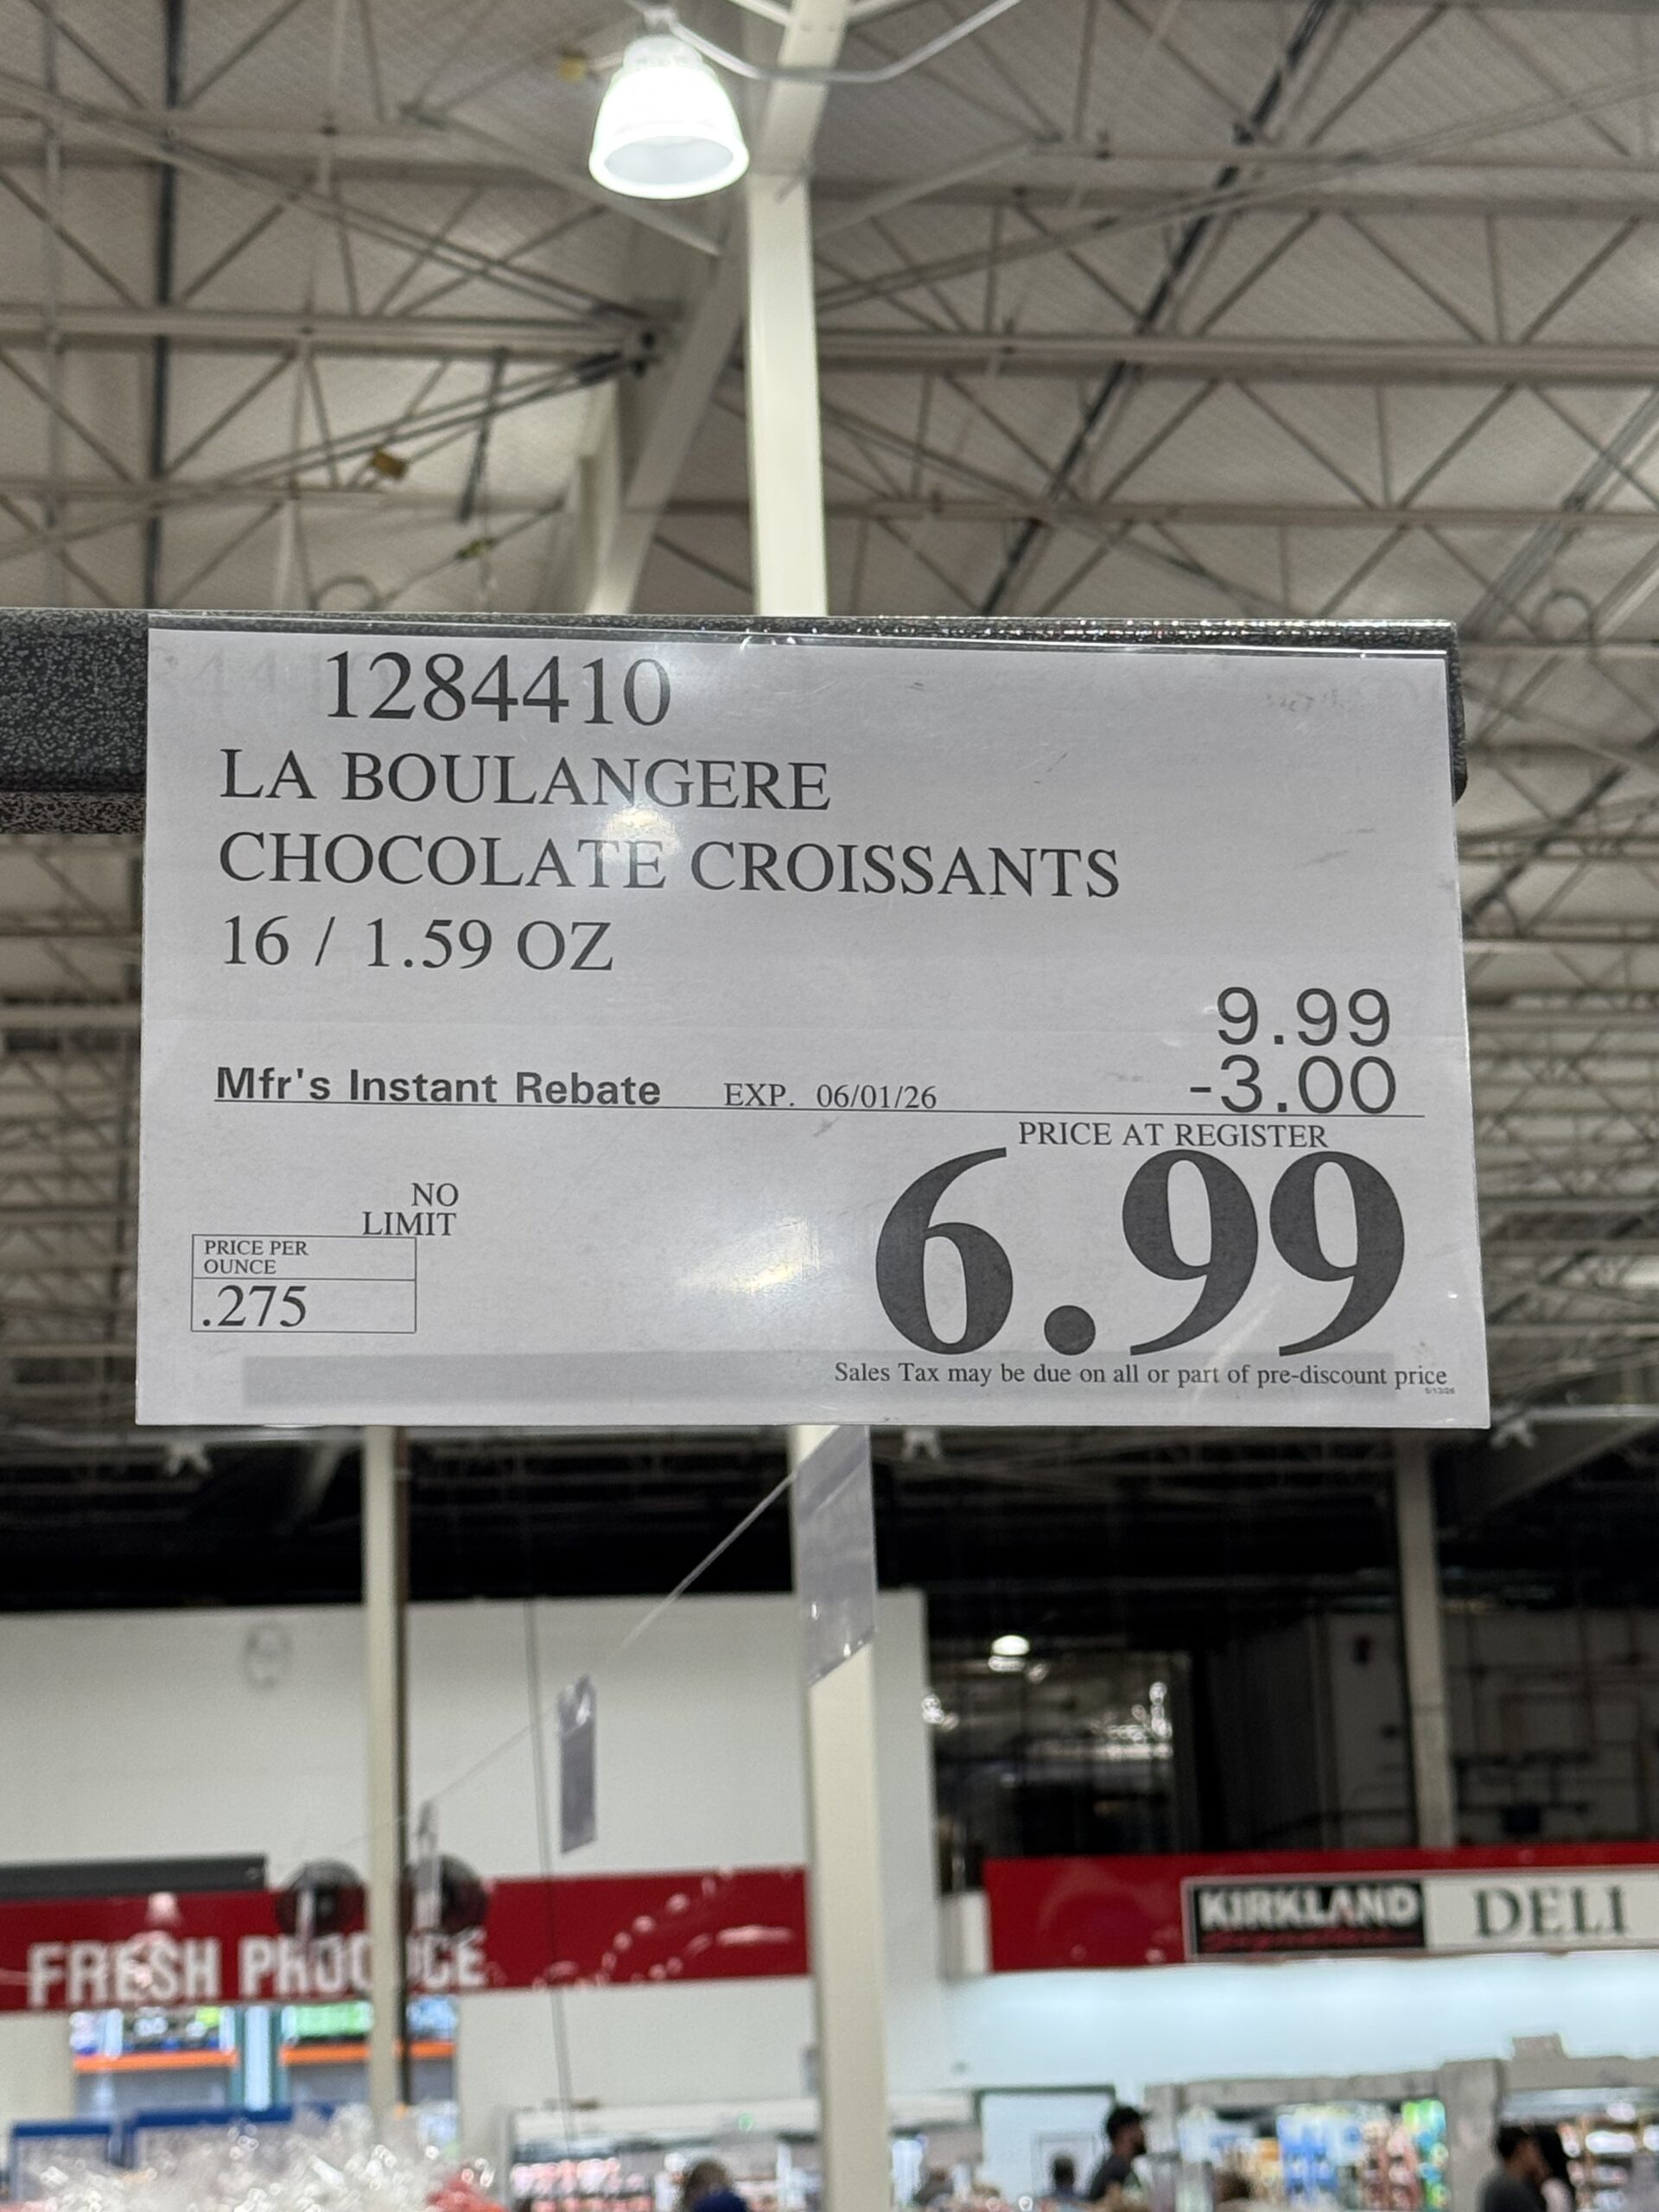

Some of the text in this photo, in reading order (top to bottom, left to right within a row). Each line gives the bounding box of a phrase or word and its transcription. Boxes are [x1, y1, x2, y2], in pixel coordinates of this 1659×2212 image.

[327, 651, 670, 726] 1284410
[220, 749, 830, 810] LA BOULANGERE
[220, 831, 1119, 898] CHOCOLATE CROISSANTS
[225, 916, 613, 970] 16 / 1.59 OZ
[1217, 987, 1389, 1046] 9.99
[216, 1054, 1395, 1114] Mfr's Instant Rebate EXP. 06/01/26 -3.00
[1019, 1122, 1329, 1147] PRICE AT REGISTER
[411, 1183, 459, 1206] NO
[205, 1240, 308, 1255] PRICE PER
[362, 1211, 456, 1236] LIMIT
[204, 1259, 276, 1274] OUNCE
[876, 1147, 1404, 1357] 6.99
[203, 1285, 307, 1327] .275
[836, 1363, 1447, 1390] Sales Tax may be due on all or part of pre-discount price
[1200, 1884, 1419, 1929] KIRKLAND
[1475, 1884, 1630, 1937] DELI
[29, 1938, 219, 2005] FRESH
